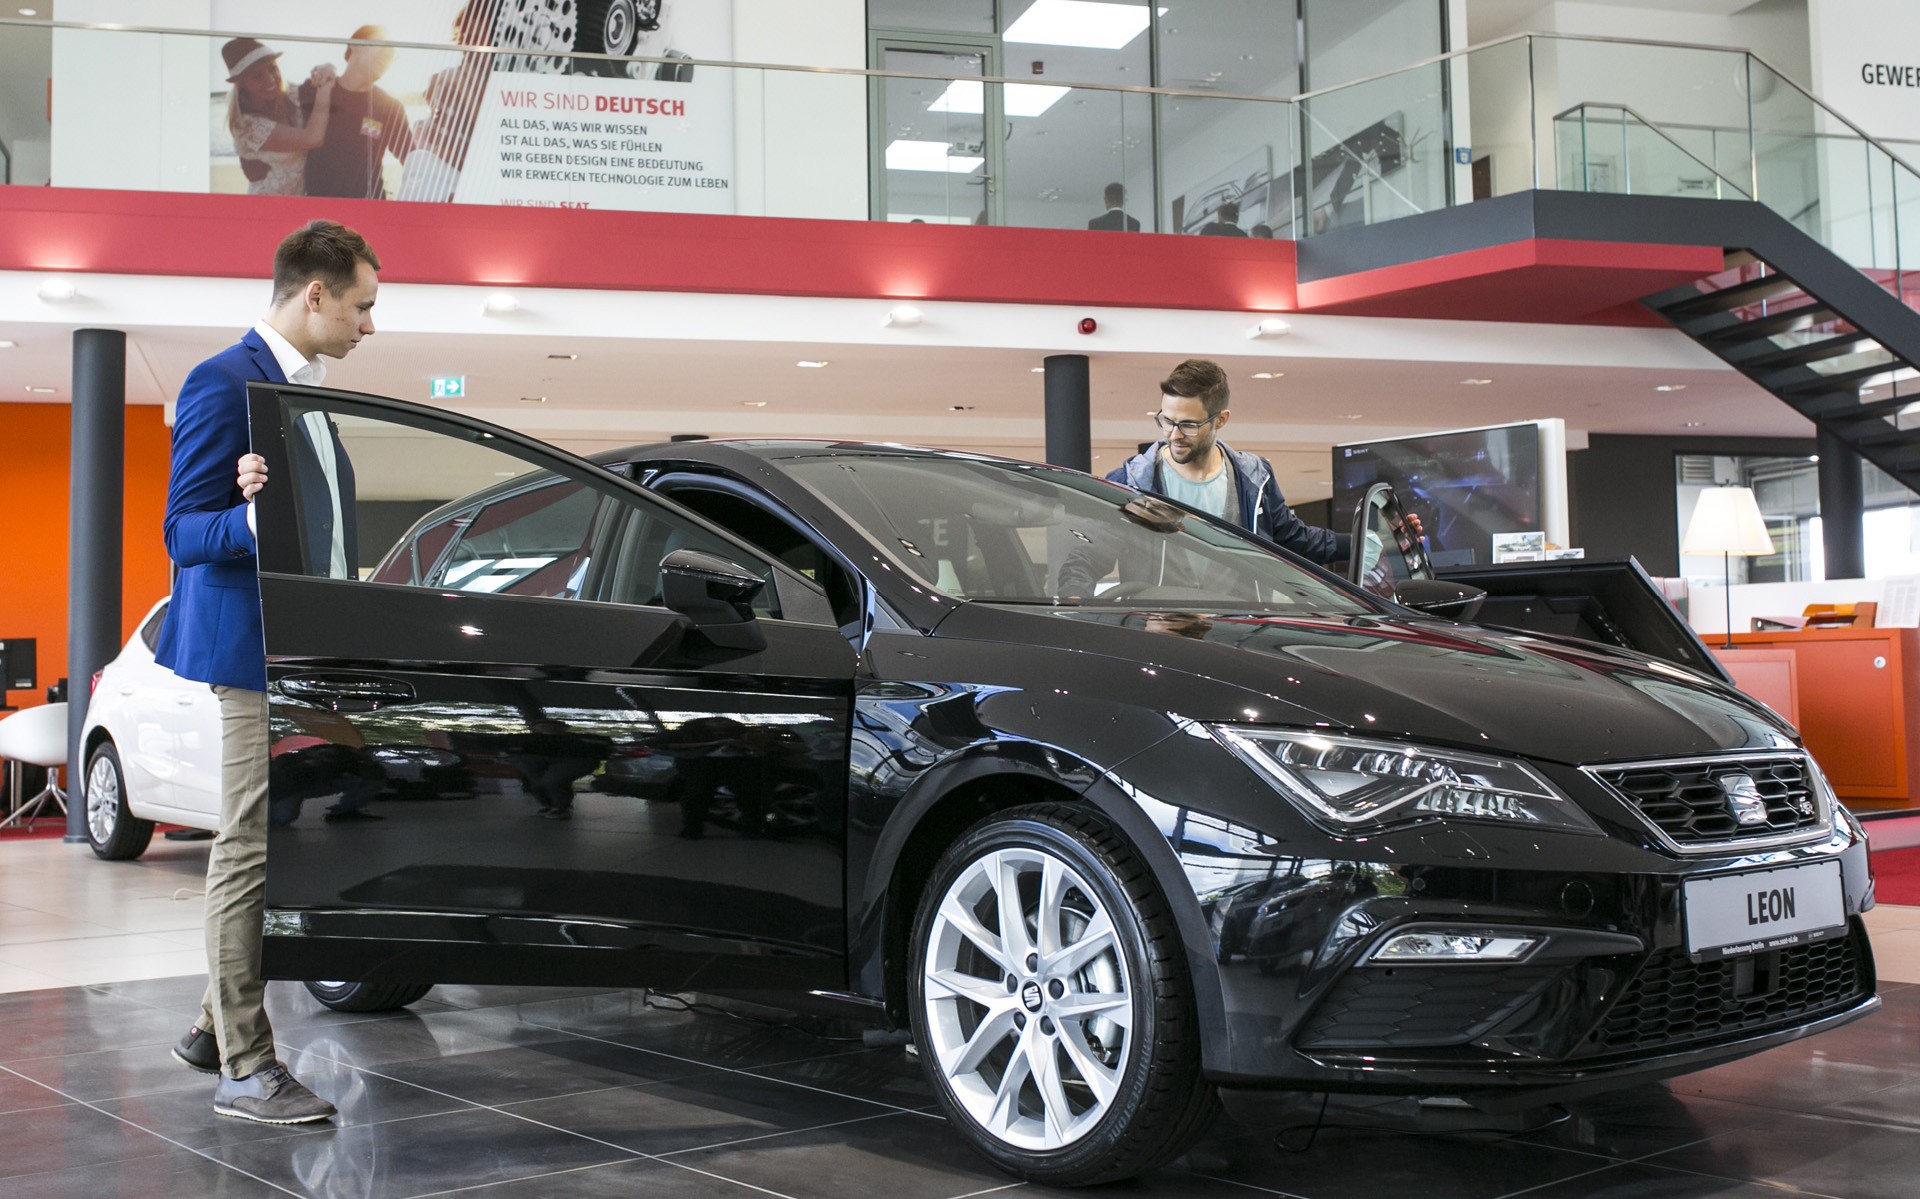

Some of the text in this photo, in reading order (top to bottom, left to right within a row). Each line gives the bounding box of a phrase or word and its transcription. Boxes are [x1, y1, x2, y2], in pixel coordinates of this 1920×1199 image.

[500, 89, 685, 117] WIR SIND DEUTSCH
[500, 118, 648, 136] ALL DAS, WAS WIR WISSEN
[500, 135, 663, 153] IST ALL DAS, WAS SIE FÜHLEN
[500, 152, 704, 172] WIR GEBEN DESIGN EINE BEDEUTUNG
[500, 168, 729, 189] WIR ERWECKEN TECHNOLOGIE ZUM LEBEN
[1747, 887, 1796, 926] LEON
